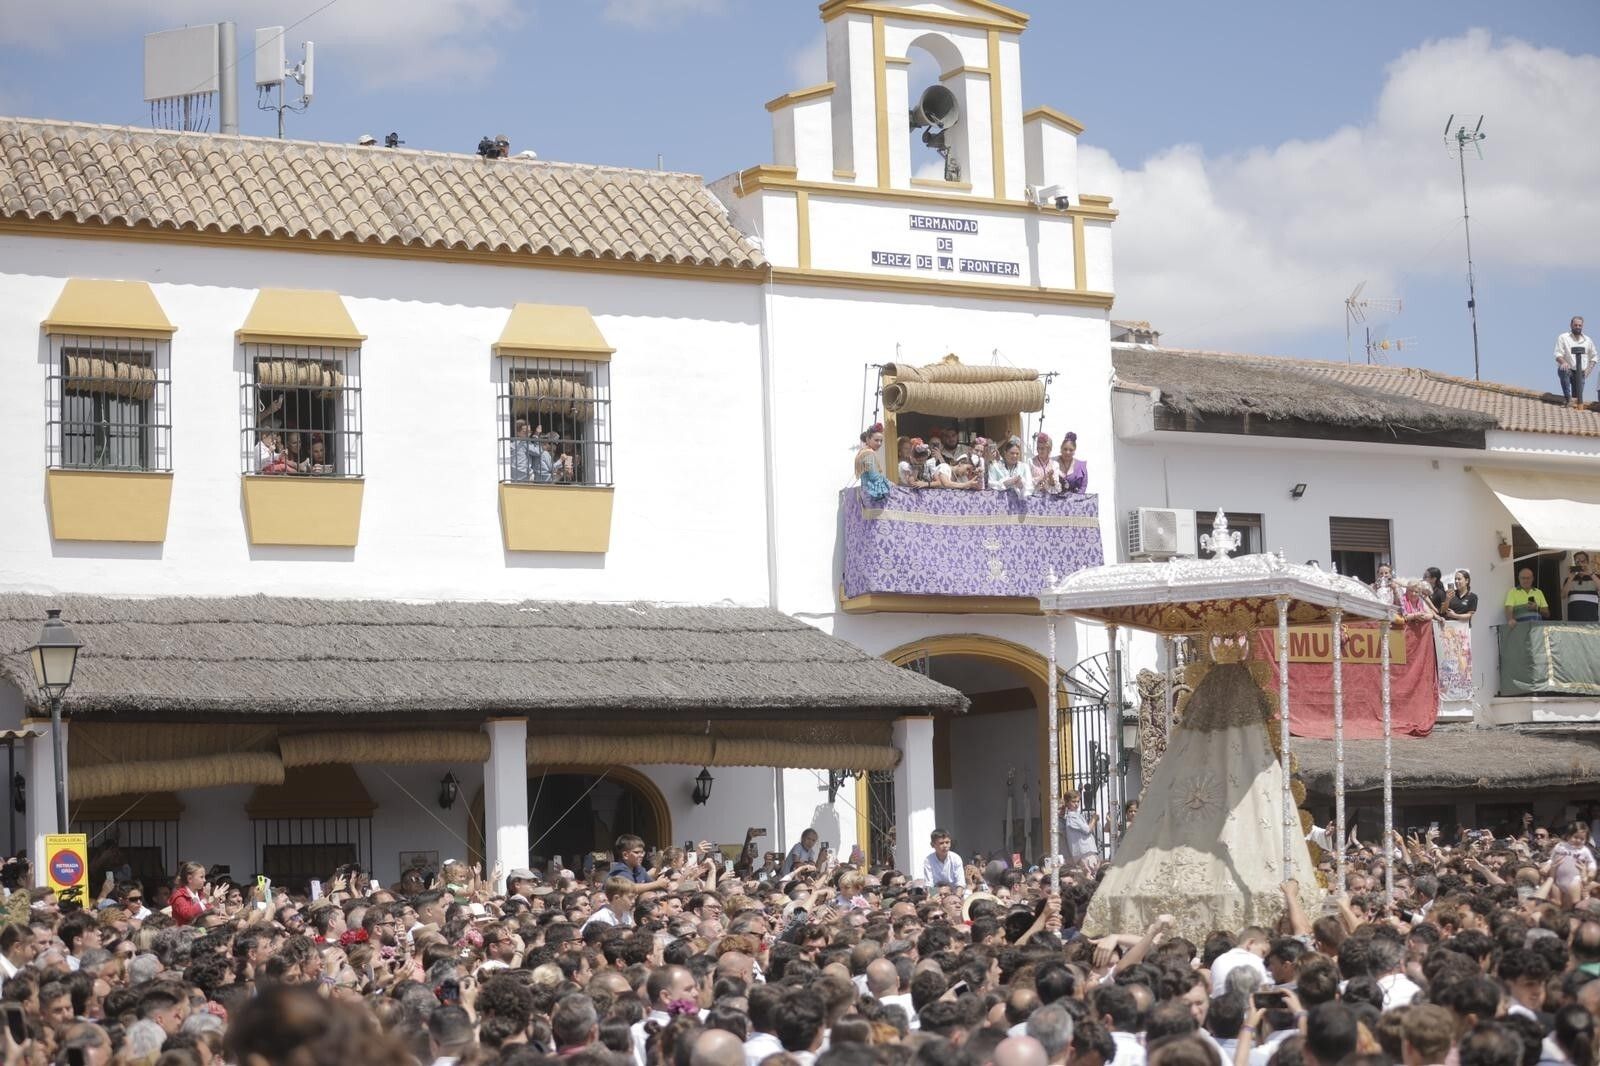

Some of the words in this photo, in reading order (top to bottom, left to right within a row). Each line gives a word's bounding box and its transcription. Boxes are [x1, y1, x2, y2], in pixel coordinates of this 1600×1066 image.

[910, 215, 978, 232] HERMANDAD
[937, 238, 953, 251] DE
[872, 252, 911, 266] JEREZ
[917, 256, 932, 268] DE
[938, 257, 953, 270] LA
[959, 259, 1020, 275] FRONTERA
